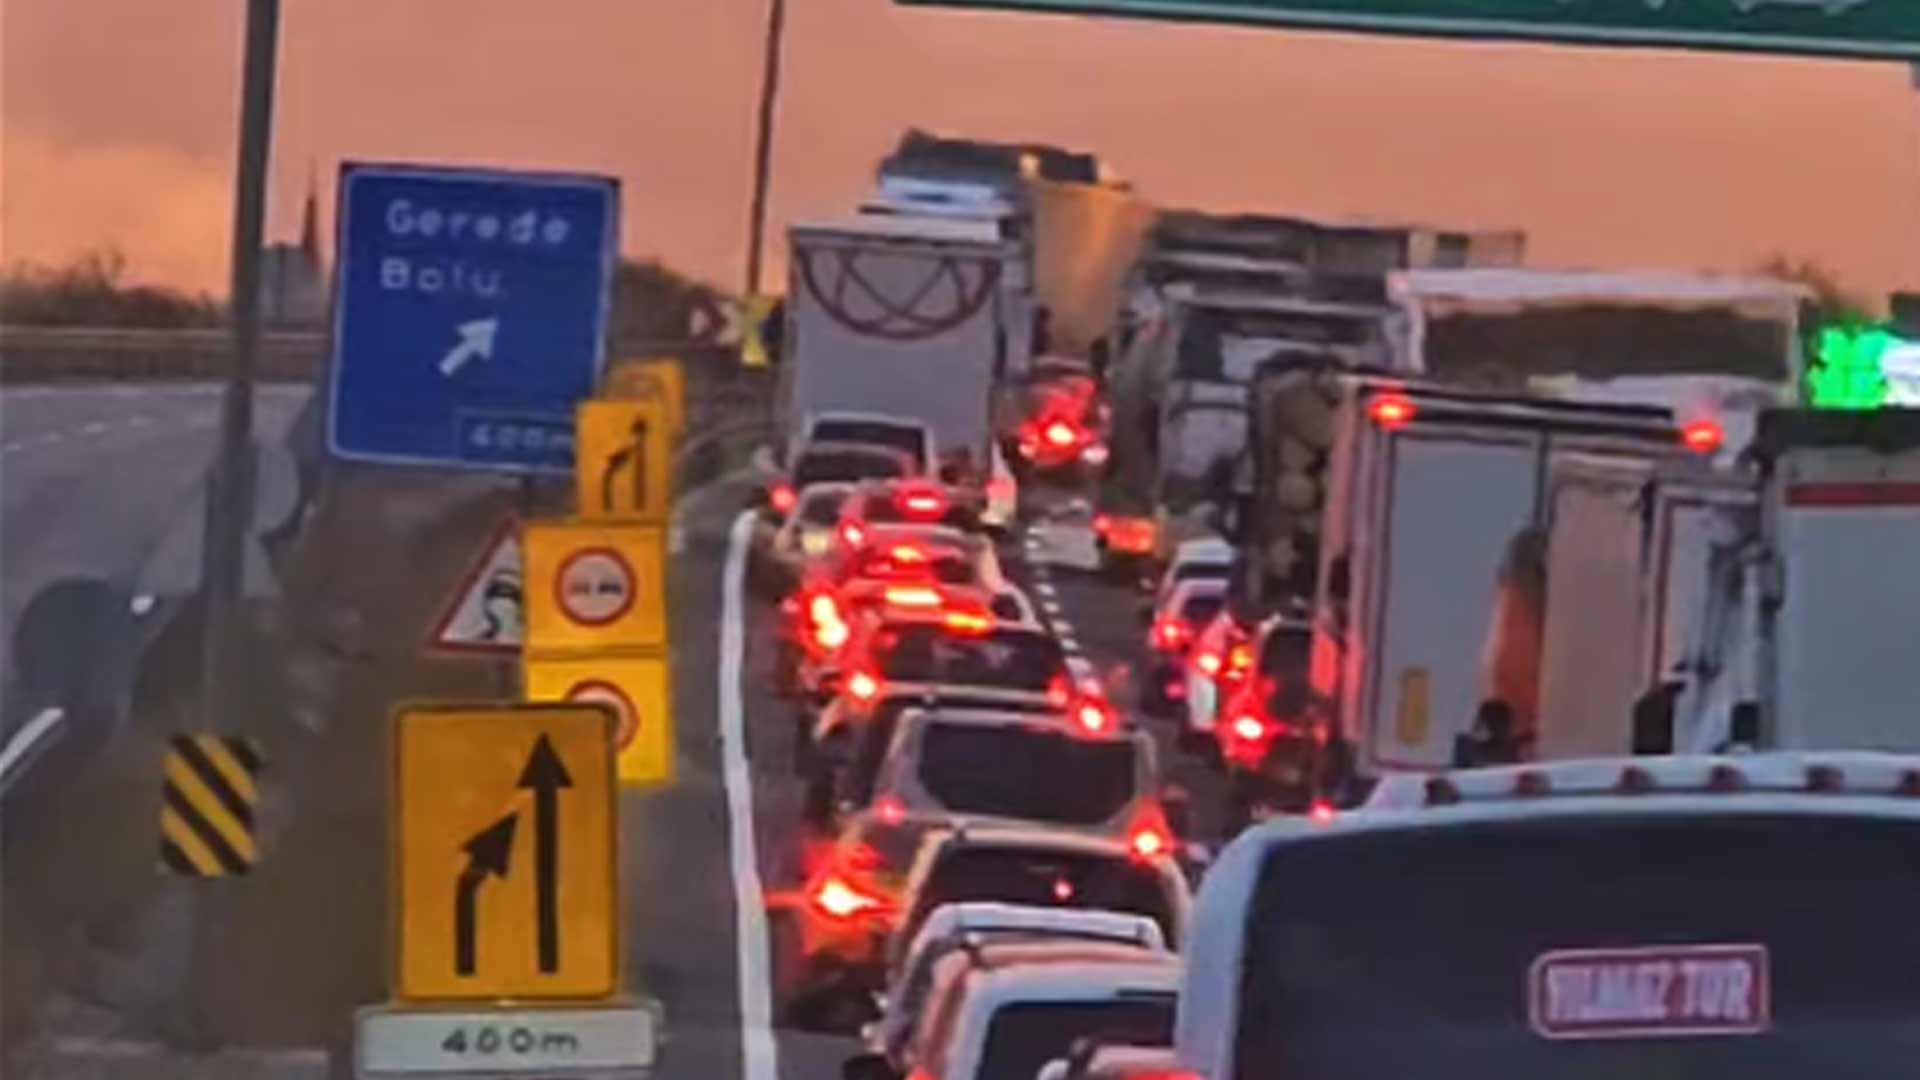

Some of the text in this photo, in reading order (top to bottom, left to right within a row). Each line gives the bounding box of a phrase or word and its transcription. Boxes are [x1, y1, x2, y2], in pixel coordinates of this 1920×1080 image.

[386, 199, 570, 244] Gerede
[380, 258, 501, 295] Bolu
[1680, 960, 1751, 1019] TUR
[442, 1027, 577, 1053] 400m
